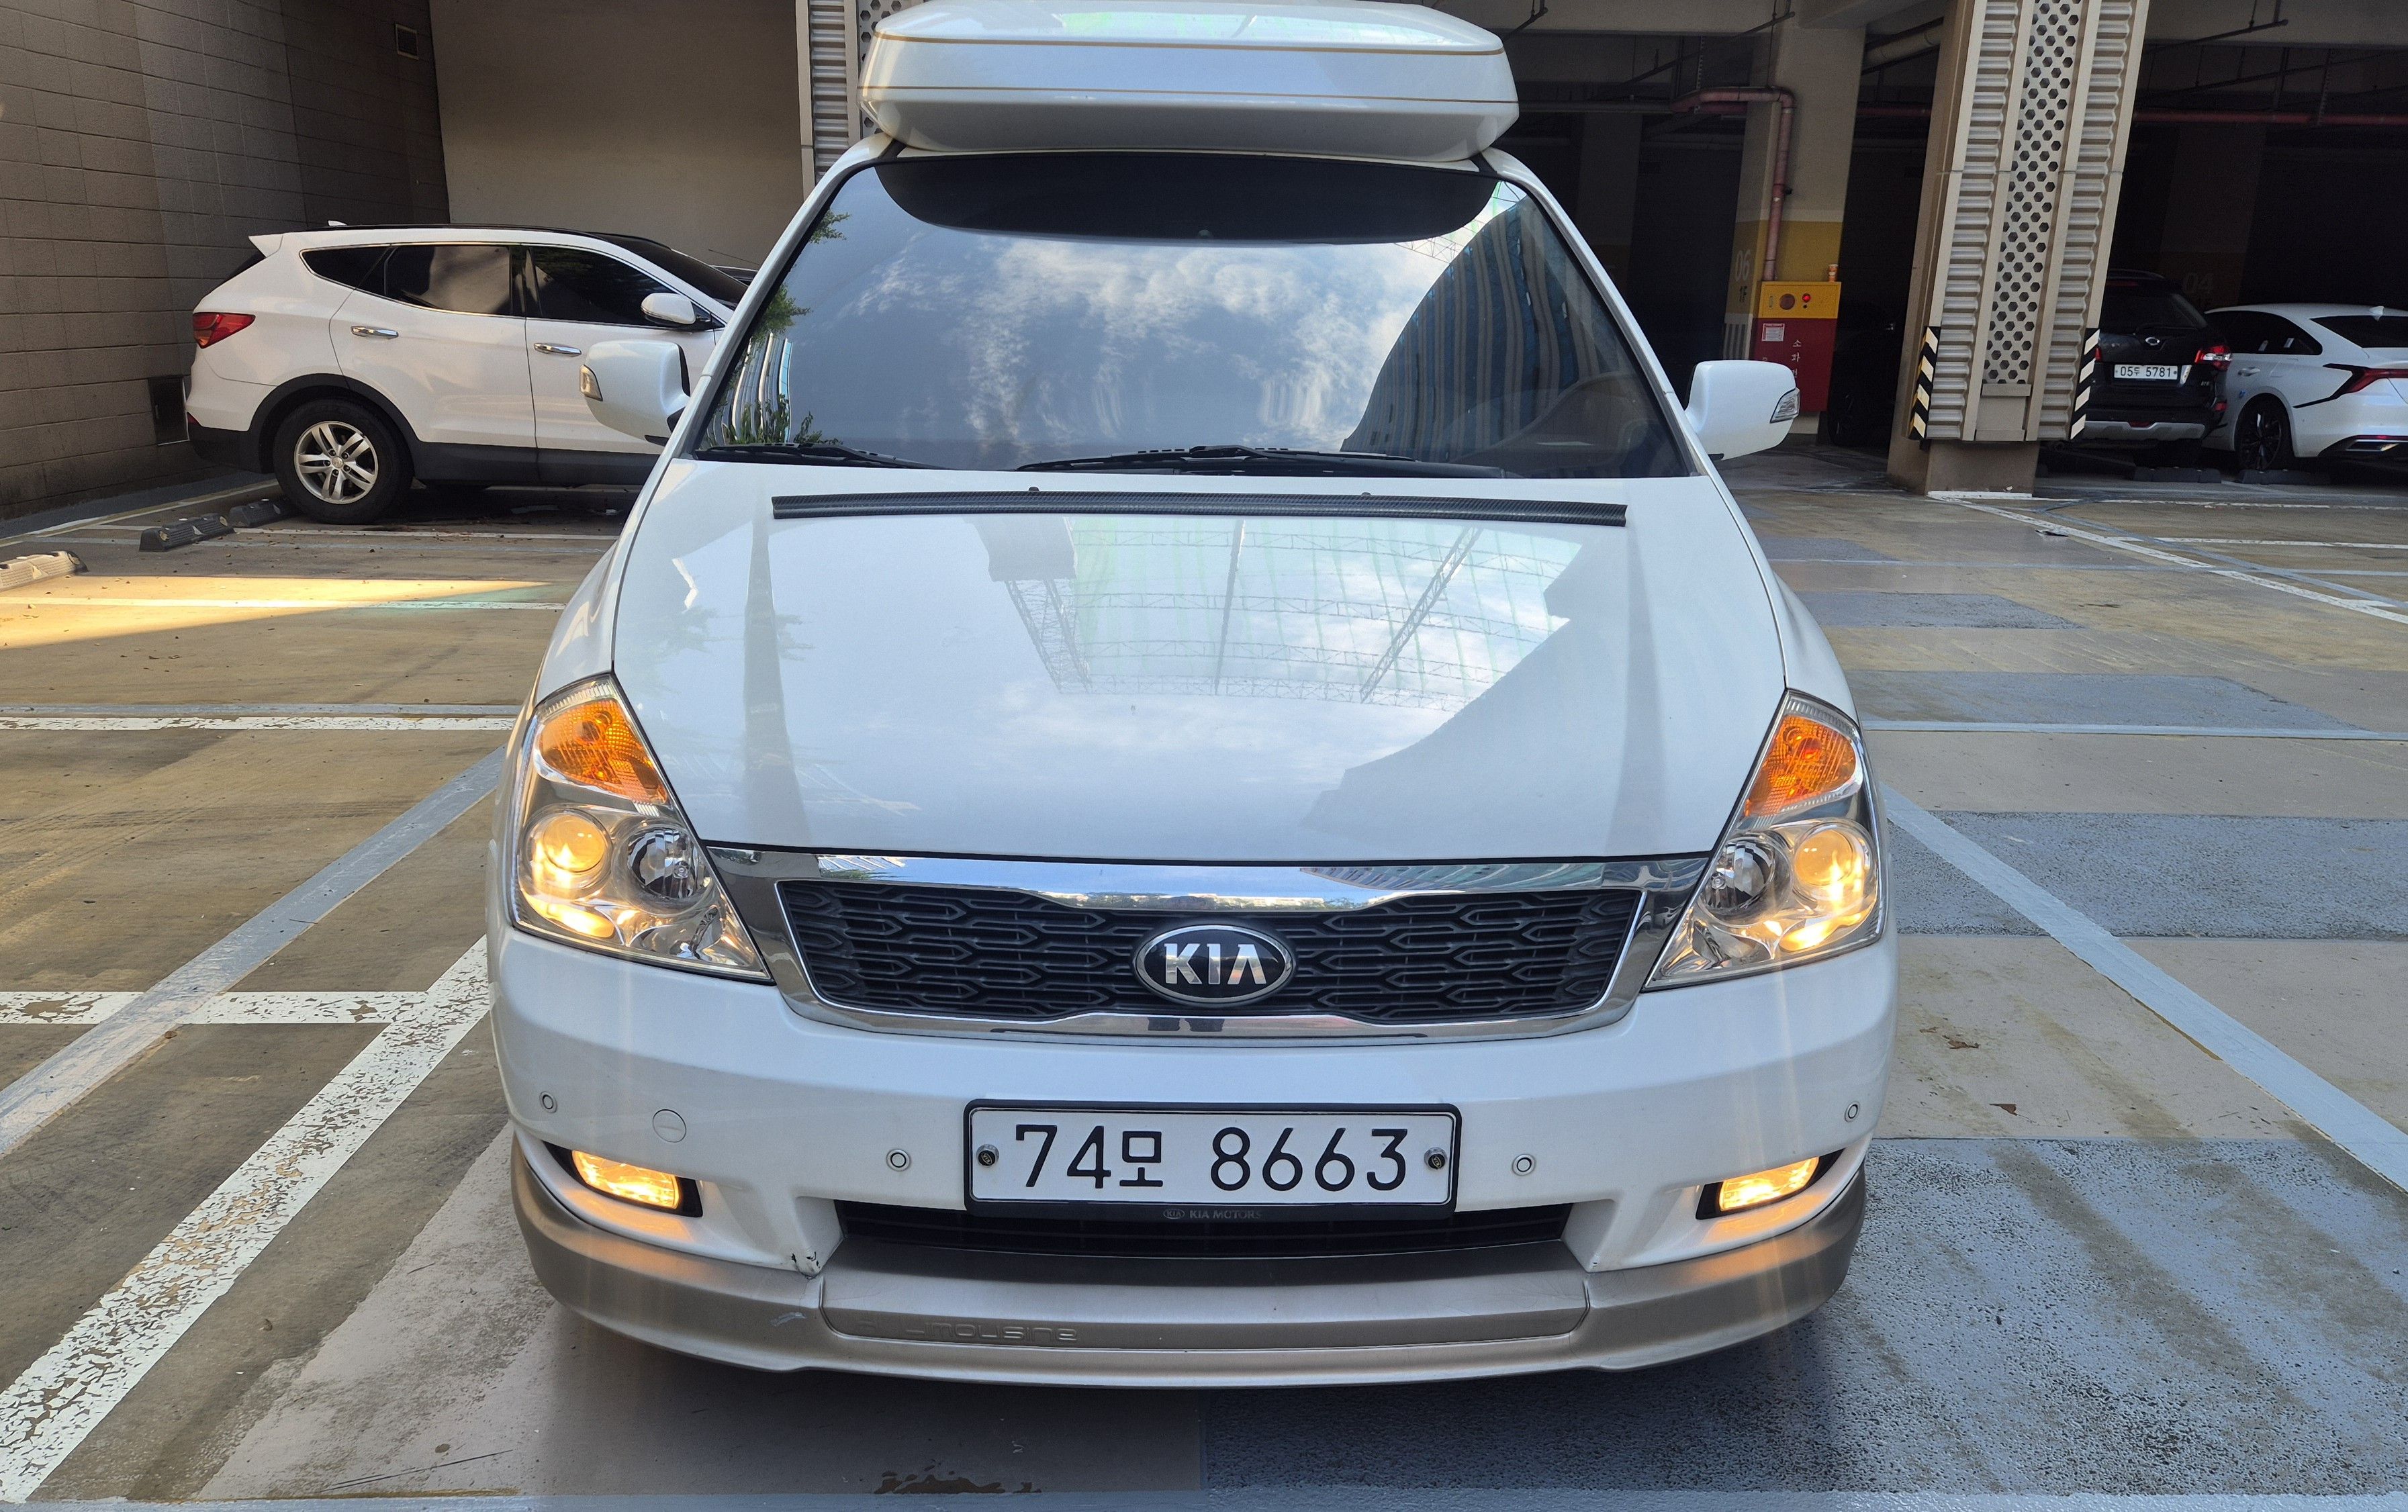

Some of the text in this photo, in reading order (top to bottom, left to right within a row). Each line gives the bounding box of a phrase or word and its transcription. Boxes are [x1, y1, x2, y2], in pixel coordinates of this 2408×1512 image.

[1735, 249, 1751, 281] 06
[2120, 366, 2171, 377] 05두 5781
[1164, 943, 1267, 985] KIA
[1015, 1124, 1408, 1192] 74모 8663
[1189, 1209, 1260, 1219] KIA MOTORS
